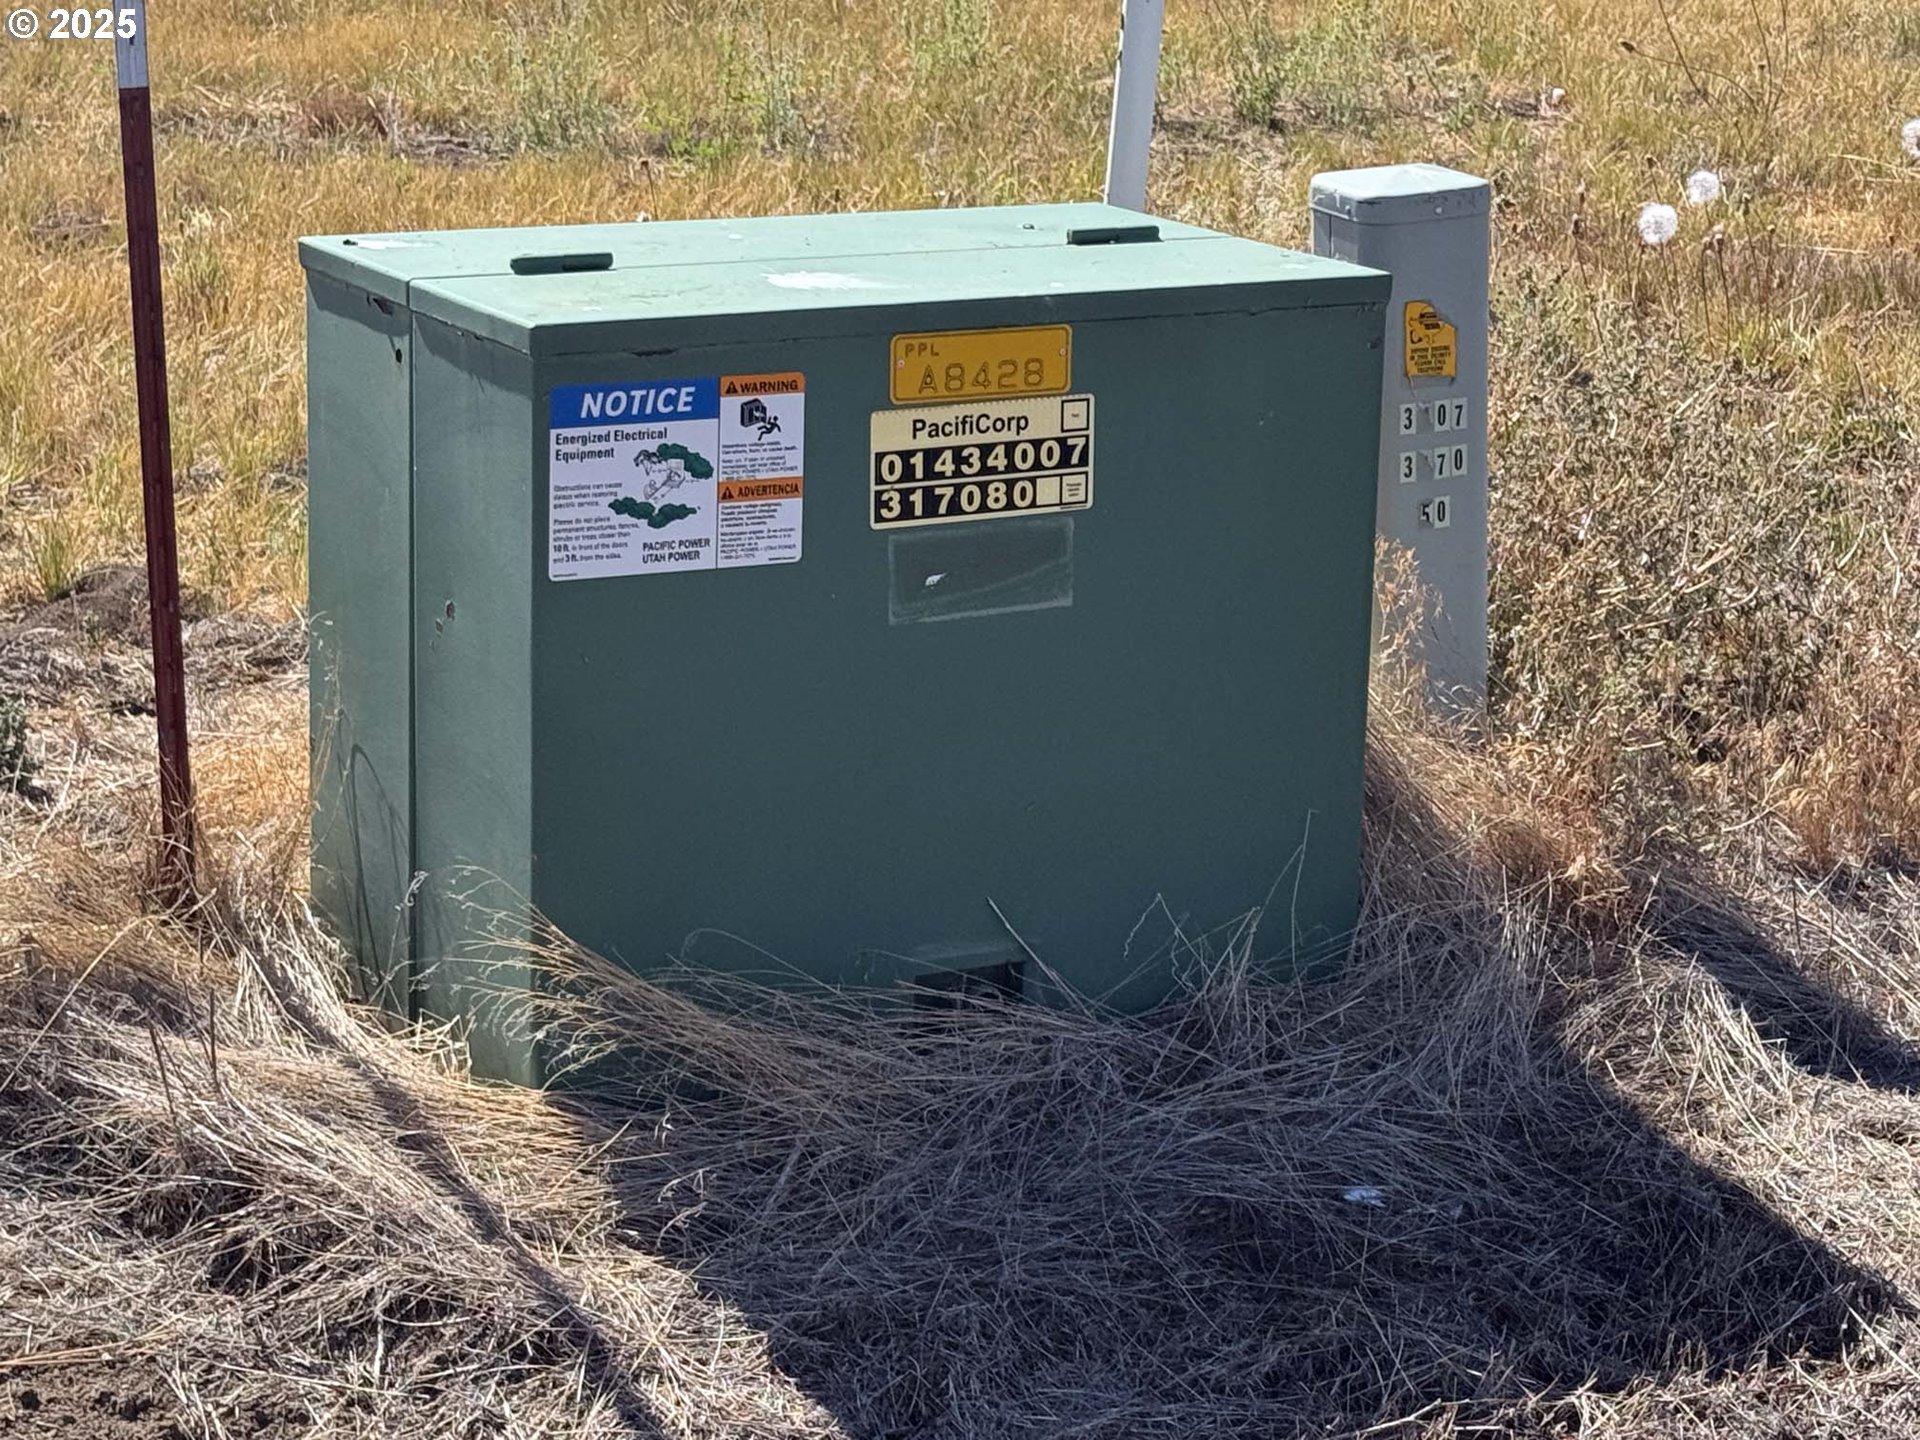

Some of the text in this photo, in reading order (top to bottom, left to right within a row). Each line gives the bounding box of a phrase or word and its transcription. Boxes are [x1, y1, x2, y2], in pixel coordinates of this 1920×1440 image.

[905, 343, 940, 358] PPL
[918, 358, 1044, 394] A8428
[740, 379, 798, 393] WARNING
[580, 386, 696, 419] NOTICE
[912, 413, 1029, 440] PacifiCorp
[555, 427, 667, 446] Energized Electrical
[555, 448, 615, 464] Equipment
[881, 437, 1087, 482] 01434007
[737, 482, 800, 497] ADVERTENCIA
[880, 479, 1034, 519] 317080
[643, 540, 676, 552] PACIFIC
[678, 538, 711, 550] POWER
[642, 550, 700, 564] UTAH POWER
